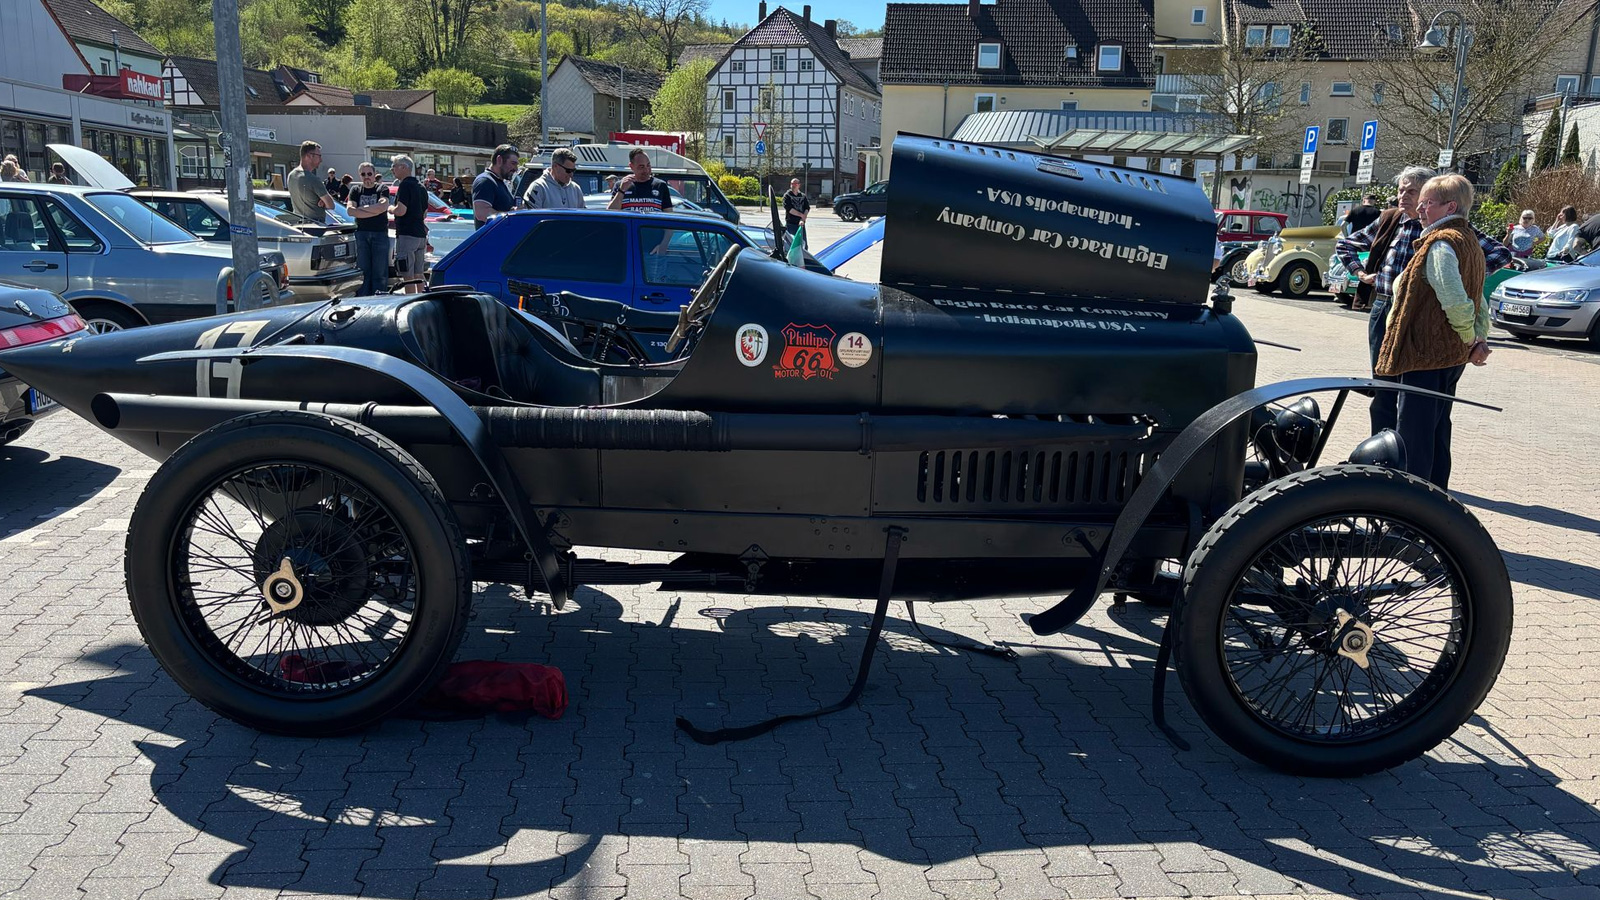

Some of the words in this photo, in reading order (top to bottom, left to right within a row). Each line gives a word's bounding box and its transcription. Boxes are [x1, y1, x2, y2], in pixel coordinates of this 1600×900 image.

[127, 74, 162, 98] nahkauf
[1306, 130, 1316, 150] P
[1364, 125, 1374, 147] P
[987, 187, 1022, 207] USA
[1282, 181, 1335, 212] HSV
[1025, 195, 1133, 230] Indianapolis
[937, 206, 1026, 241] Company
[1029, 228, 1063, 249] Car
[1067, 235, 1114, 259] Race
[1116, 245, 1168, 270] Elgin
[933, 299, 988, 309] Elgin
[990, 302, 1039, 310] Race
[1042, 304, 1075, 312] Car
[1080, 306, 1169, 320] Company
[983, 314, 1097, 329] Indianapolis
[1098, 321, 1137, 332] USA
[786, 328, 829, 349] Phillips
[847, 335, 864, 349] 14
[792, 349, 825, 371] 66
[775, 369, 800, 378] MOTOR
[820, 369, 834, 380] OIL
